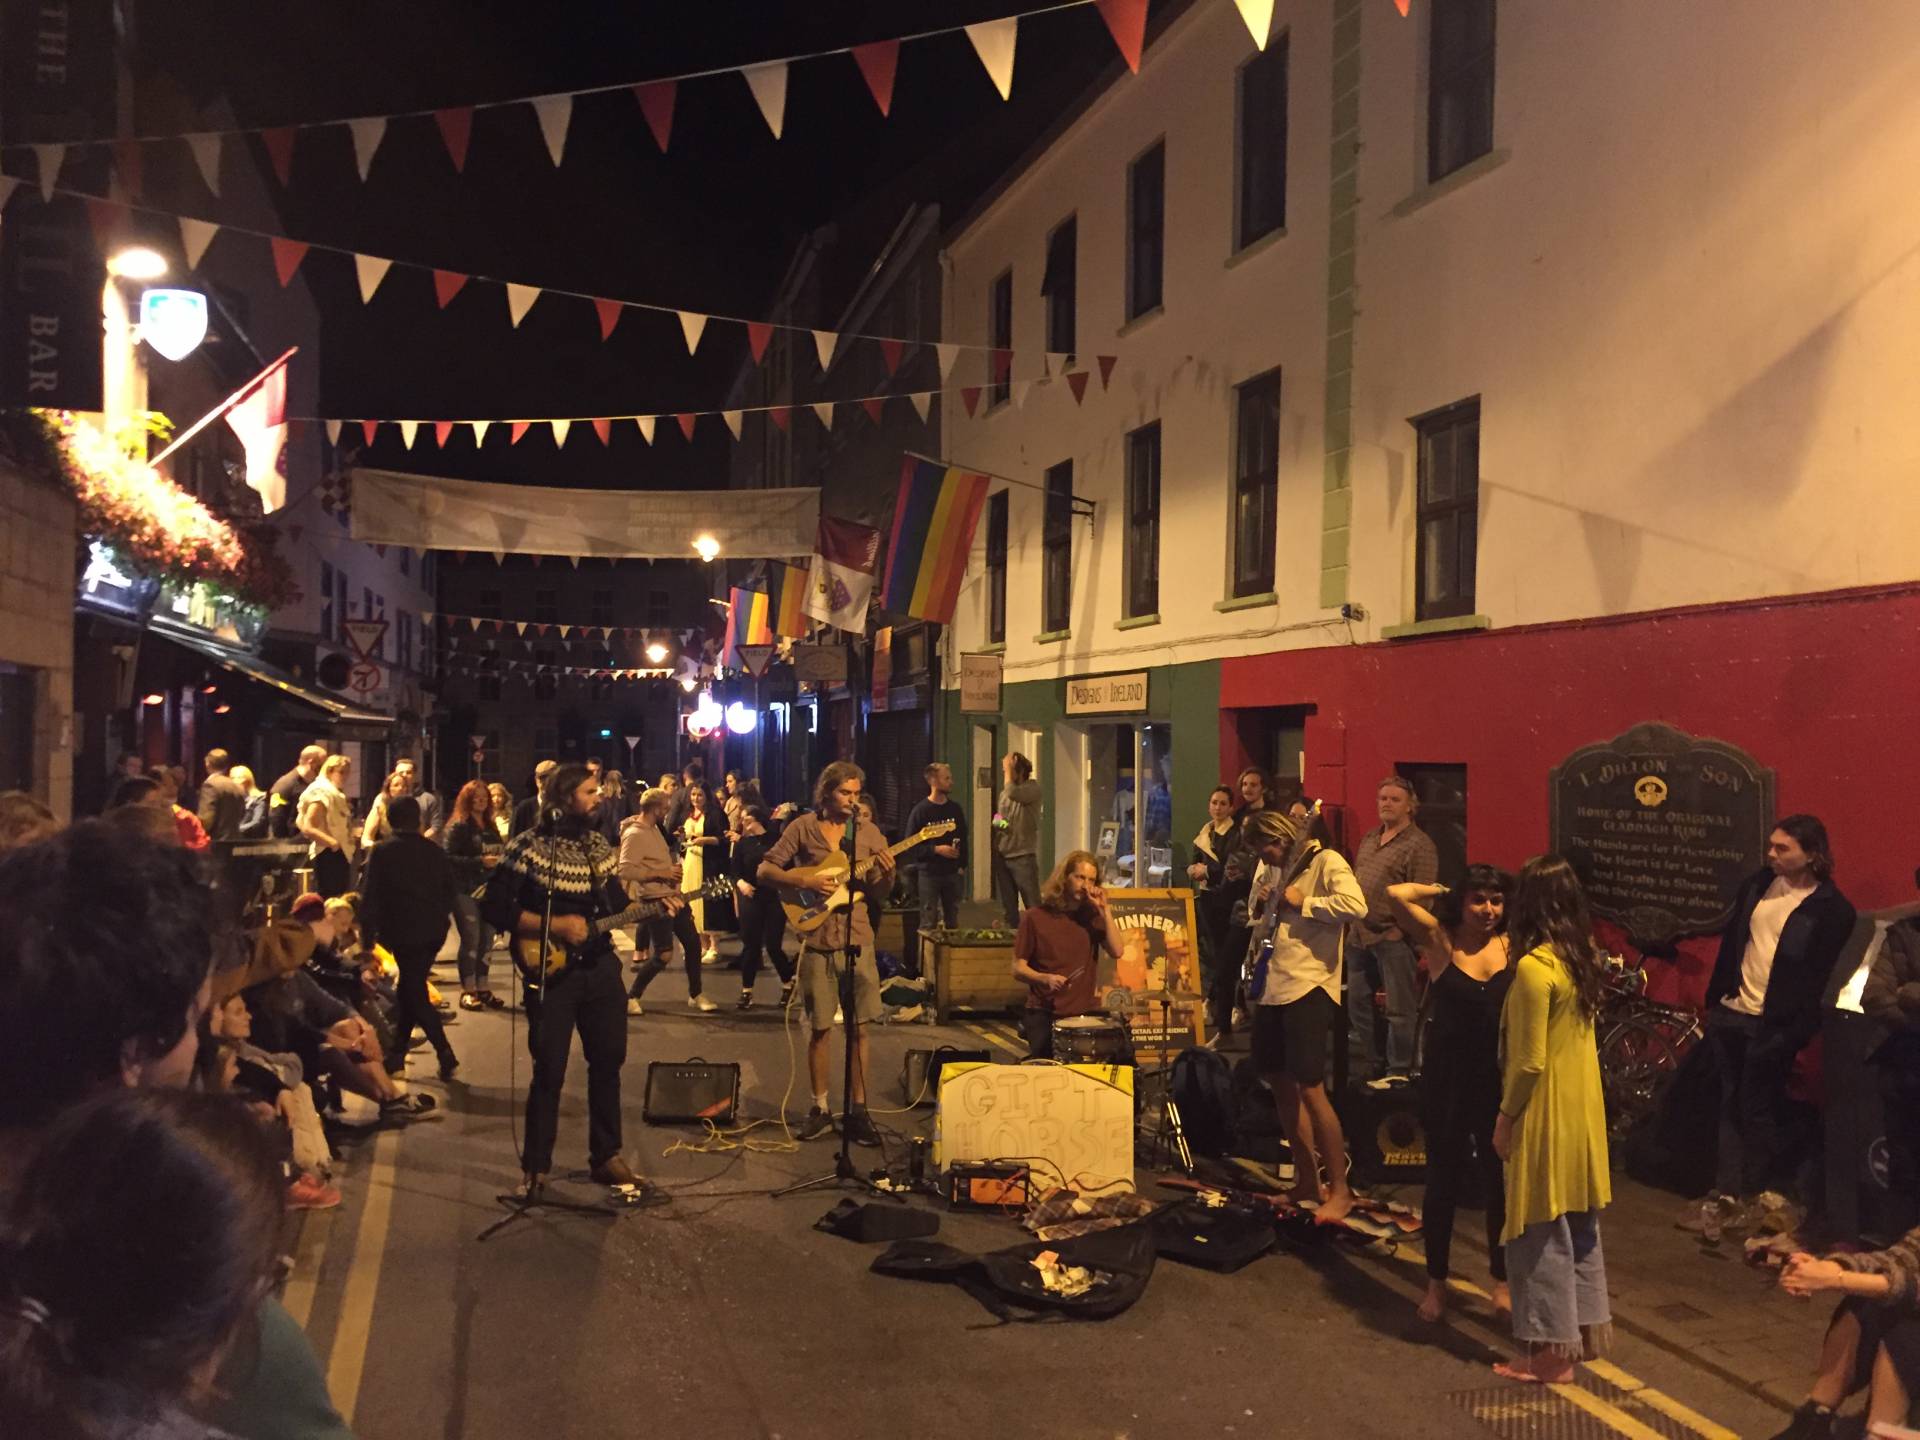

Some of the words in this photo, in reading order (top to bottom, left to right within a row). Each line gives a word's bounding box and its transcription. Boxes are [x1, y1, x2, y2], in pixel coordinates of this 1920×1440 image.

[28, 313, 60, 393] BAR
[745, 649, 769, 657] YIELD
[1636, 809, 1659, 822] THE
[1665, 811, 1732, 827] ORIGINAL
[1673, 825, 1707, 842] RING
[963, 1072, 1110, 1123] GIFT
